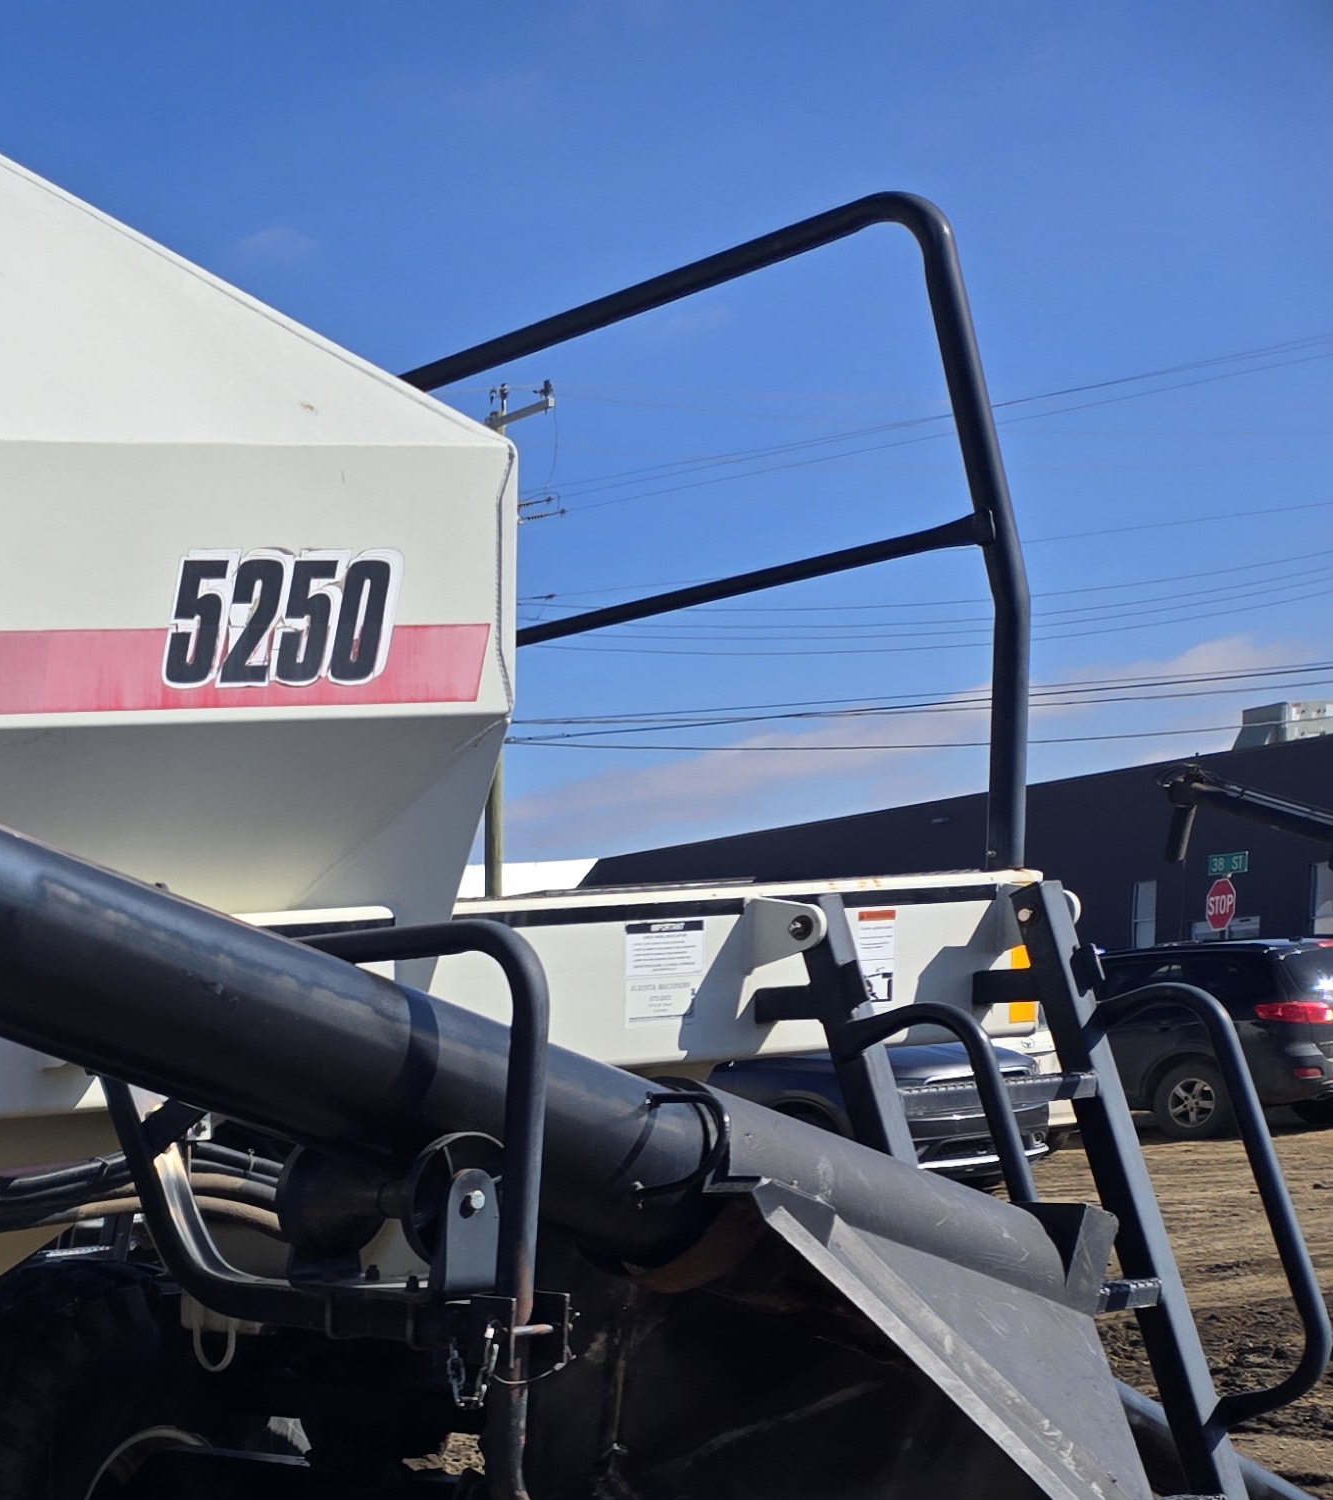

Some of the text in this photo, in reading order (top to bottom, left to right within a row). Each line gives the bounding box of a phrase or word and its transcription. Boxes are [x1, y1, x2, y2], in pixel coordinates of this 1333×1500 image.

[163, 554, 395, 687] 5250
[1211, 855, 1244, 872] 38 ST
[1208, 894, 1234, 916] STOP
